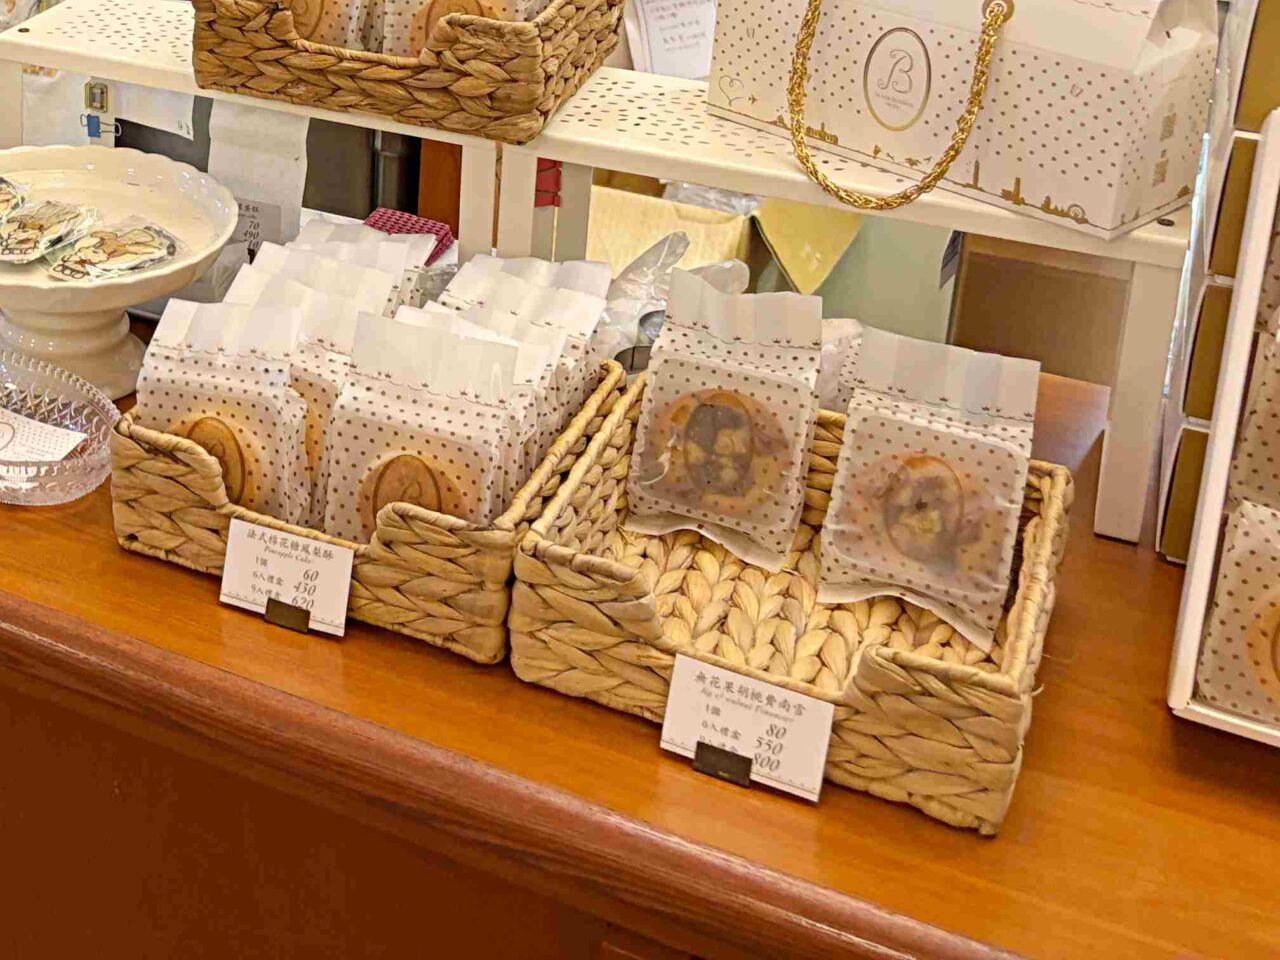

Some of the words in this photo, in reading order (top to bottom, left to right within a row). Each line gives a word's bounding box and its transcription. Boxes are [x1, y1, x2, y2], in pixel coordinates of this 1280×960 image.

[302, 569, 319, 581] 60
[766, 723, 787, 739] 80
[754, 737, 783, 755] 550
